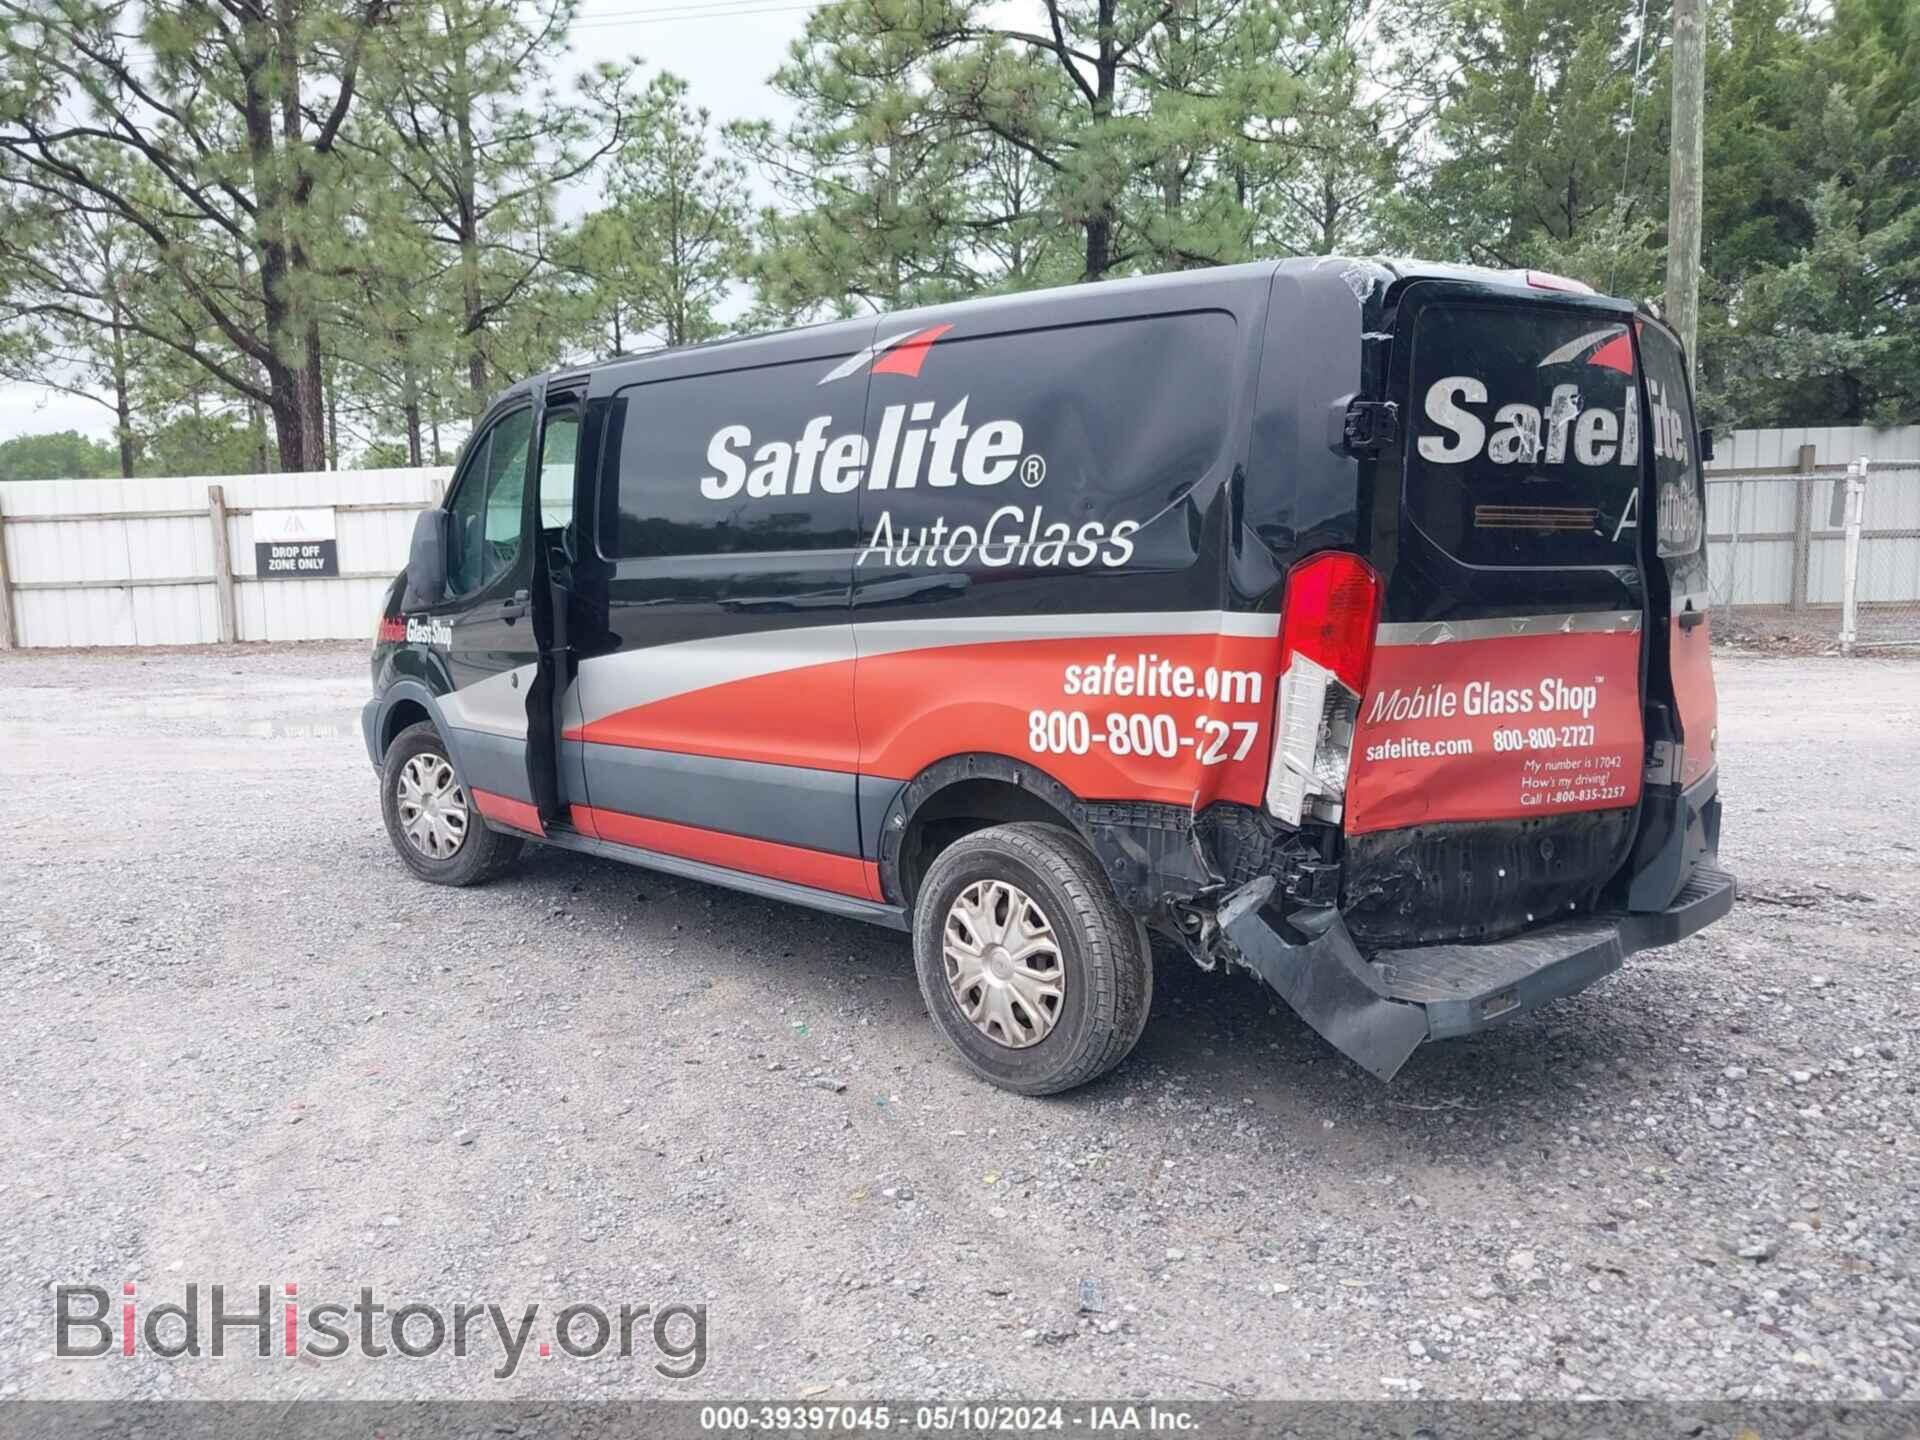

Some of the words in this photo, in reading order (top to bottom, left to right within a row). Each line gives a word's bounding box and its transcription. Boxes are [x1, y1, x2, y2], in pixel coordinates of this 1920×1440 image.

[857, 505, 1140, 568] AutoGlass
[271, 545, 300, 558] DROP
[301, 545, 321, 557] OFF
[268, 559, 297, 571] ZONE
[298, 558, 325, 570] ONLY
[406, 618, 432, 643] Glass
[1366, 683, 1457, 724] Mobile
[1463, 681, 1533, 716] Glass
[1366, 736, 1472, 761] safelite.com
[1493, 725, 1595, 752] 800-800-2727
[1524, 760, 1542, 774] My
[1545, 759, 1581, 771] number
[1584, 757, 1592, 768] is
[1521, 776, 1555, 789] How's
[1558, 777, 1573, 790] my
[1520, 792, 1543, 806] Call
[1546, 786, 1626, 804] 1-800-835-2257
